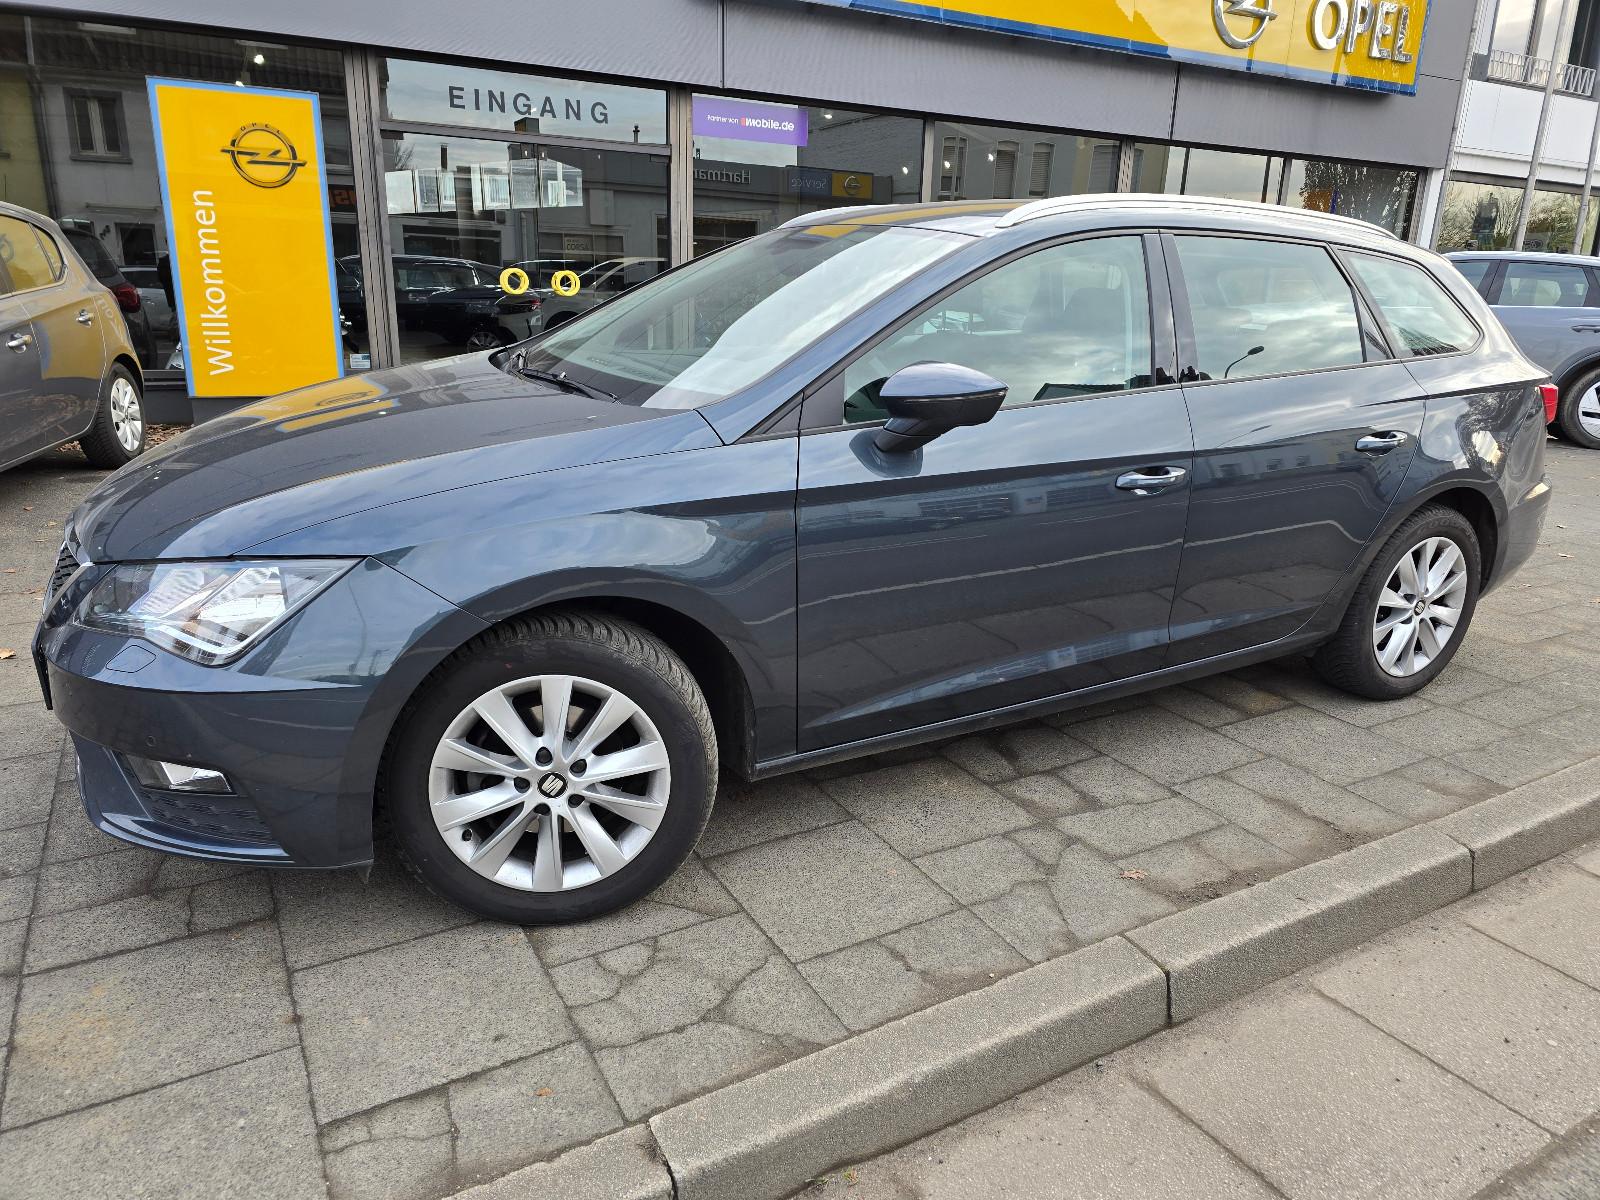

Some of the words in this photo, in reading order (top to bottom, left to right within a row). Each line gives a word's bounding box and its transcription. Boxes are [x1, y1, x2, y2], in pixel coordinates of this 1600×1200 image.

[1312, 0, 1413, 63] OPEL
[448, 85, 610, 125] EINGANG
[745, 116, 795, 131] mobile.de
[240, 122, 282, 136] OPEL
[192, 190, 235, 376] Willkommen
